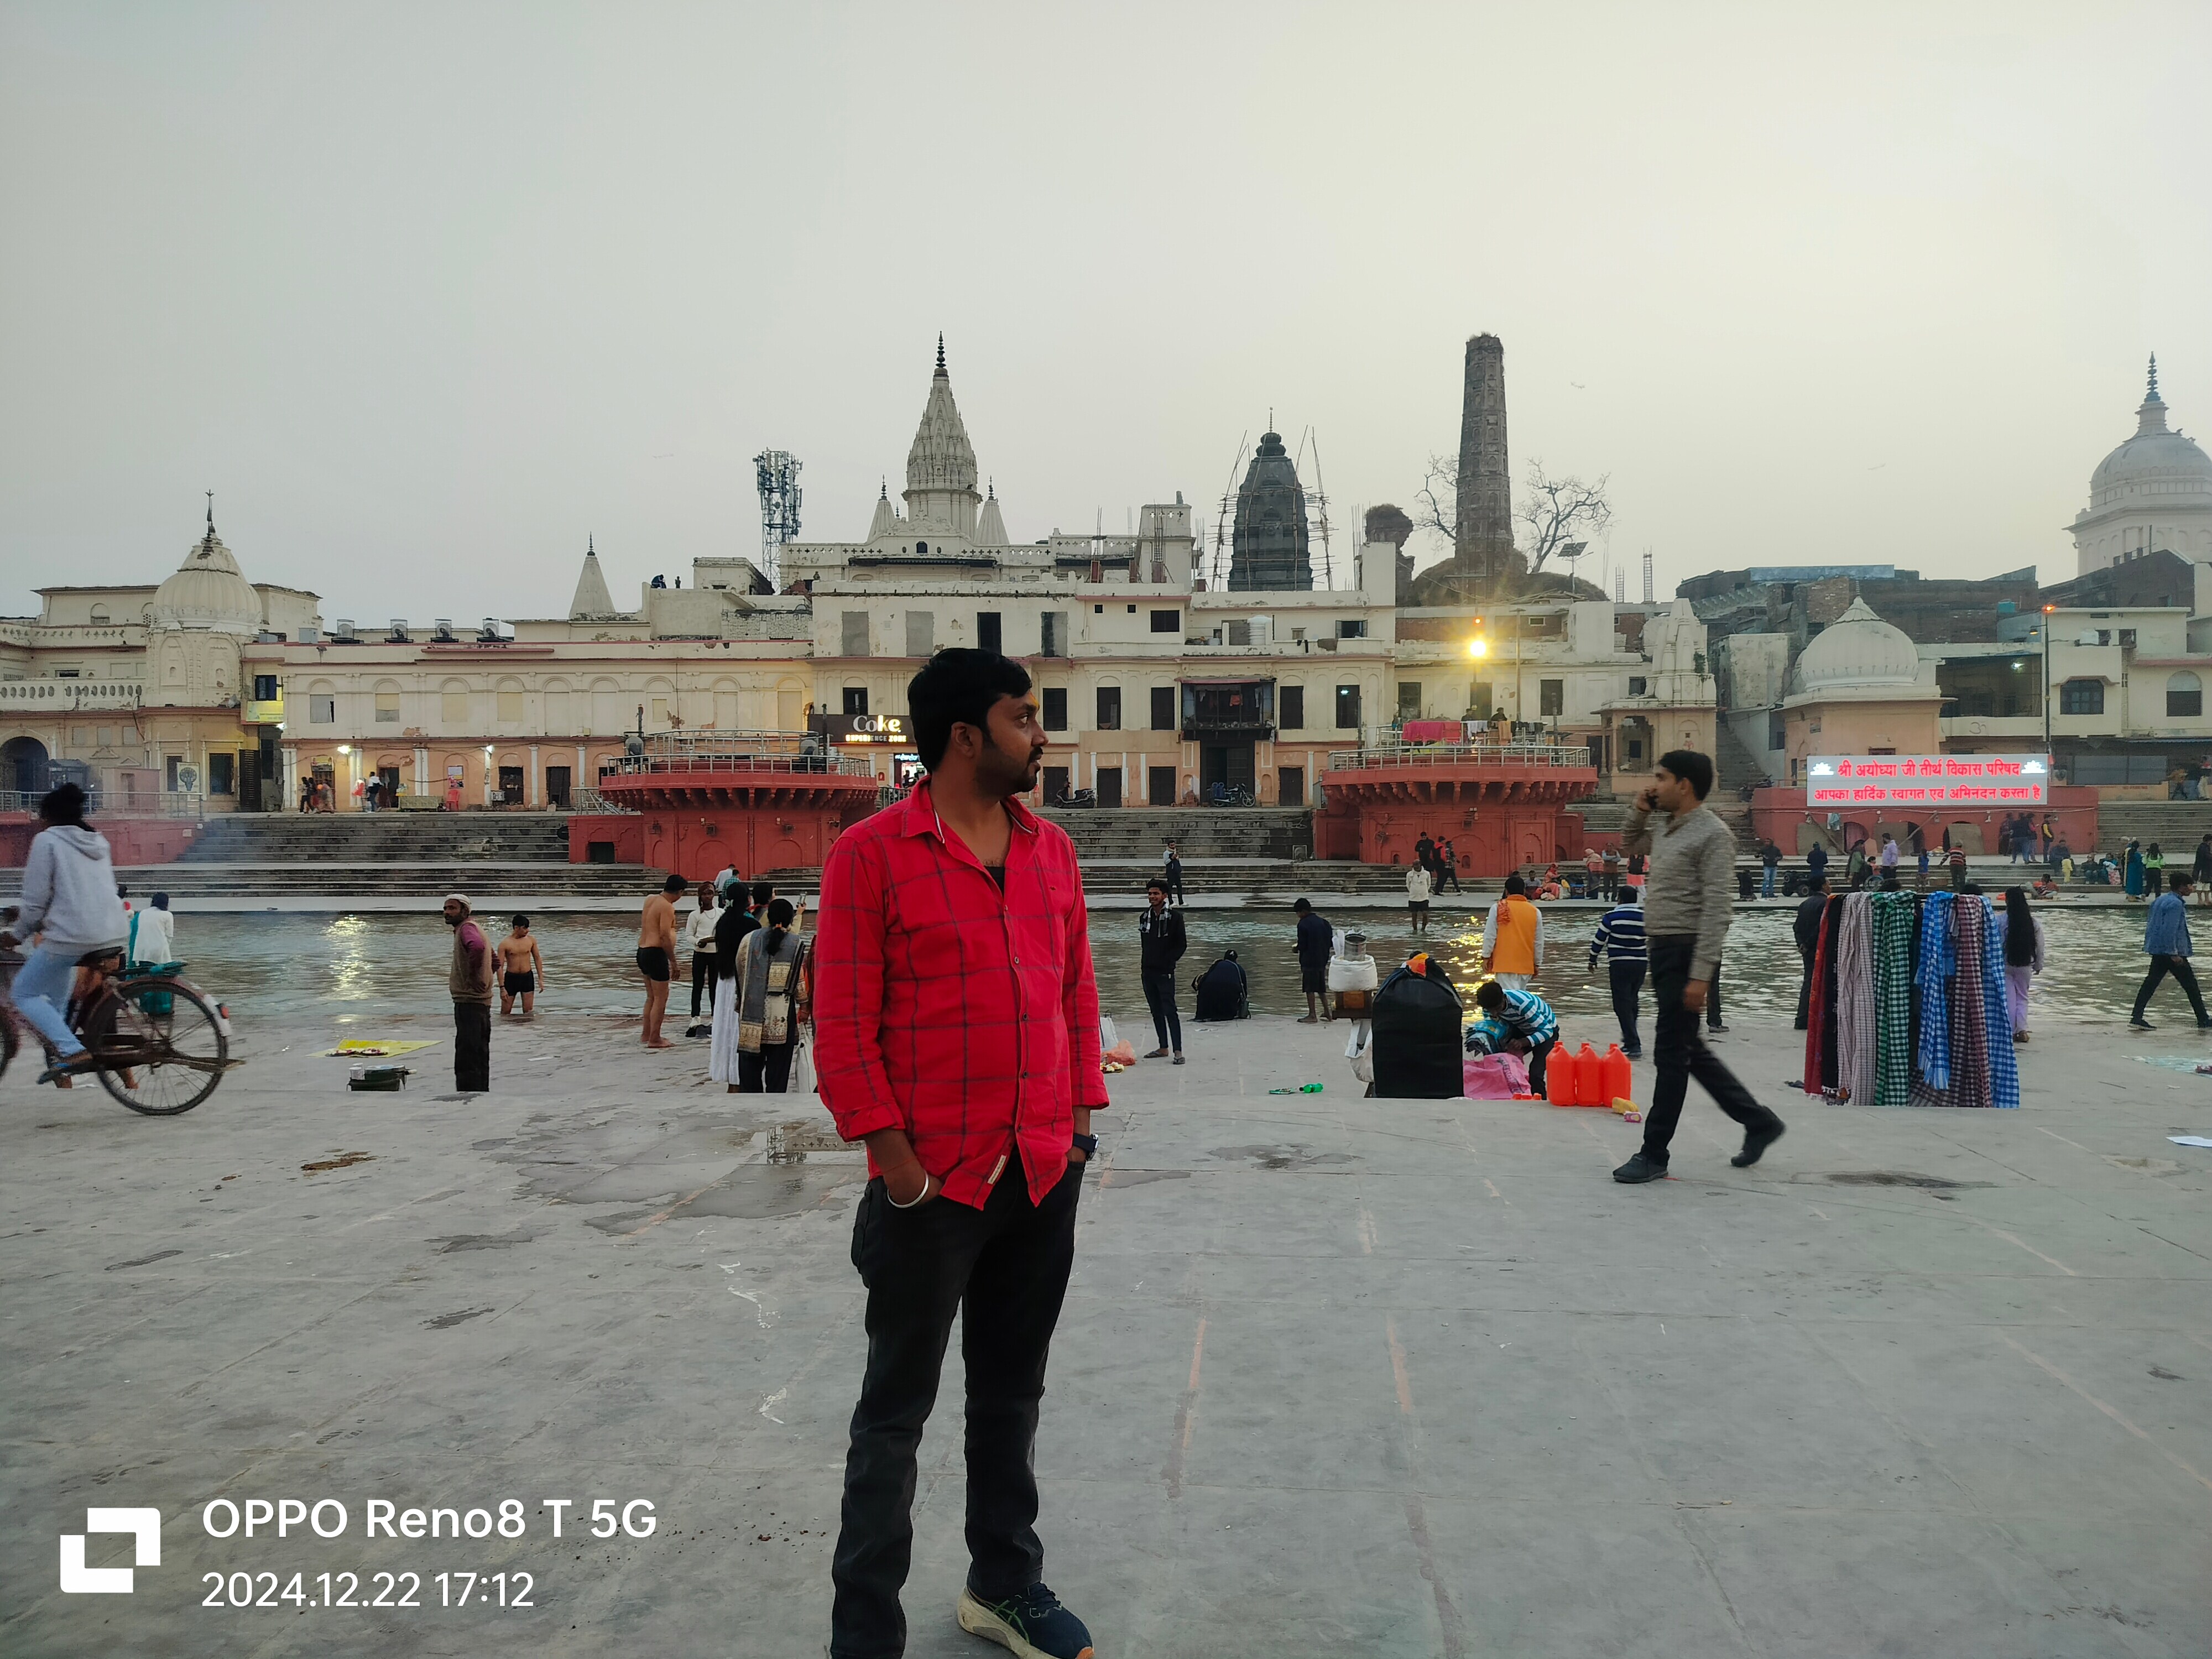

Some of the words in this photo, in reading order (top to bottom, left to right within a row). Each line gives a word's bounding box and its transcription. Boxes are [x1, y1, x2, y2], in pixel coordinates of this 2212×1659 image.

[1838, 760, 1852, 777] श्री
[1855, 759, 1897, 777] अयोध्या
[1901, 759, 1916, 776] जी
[1919, 759, 1943, 776] तीर्थ
[1945, 759, 1983, 776] विकास
[1985, 759, 2021, 776] परिषद
[1814, 789, 1850, 800] आपका
[1853, 784, 1887, 801] हार्दिक
[1890, 789, 1925, 800] स्वागत
[1928, 785, 1945, 801] एवं
[1949, 784, 1997, 799] अभिनंदन
[2000, 787, 2030, 799] करता
[2032, 783, 2042, 800] है
